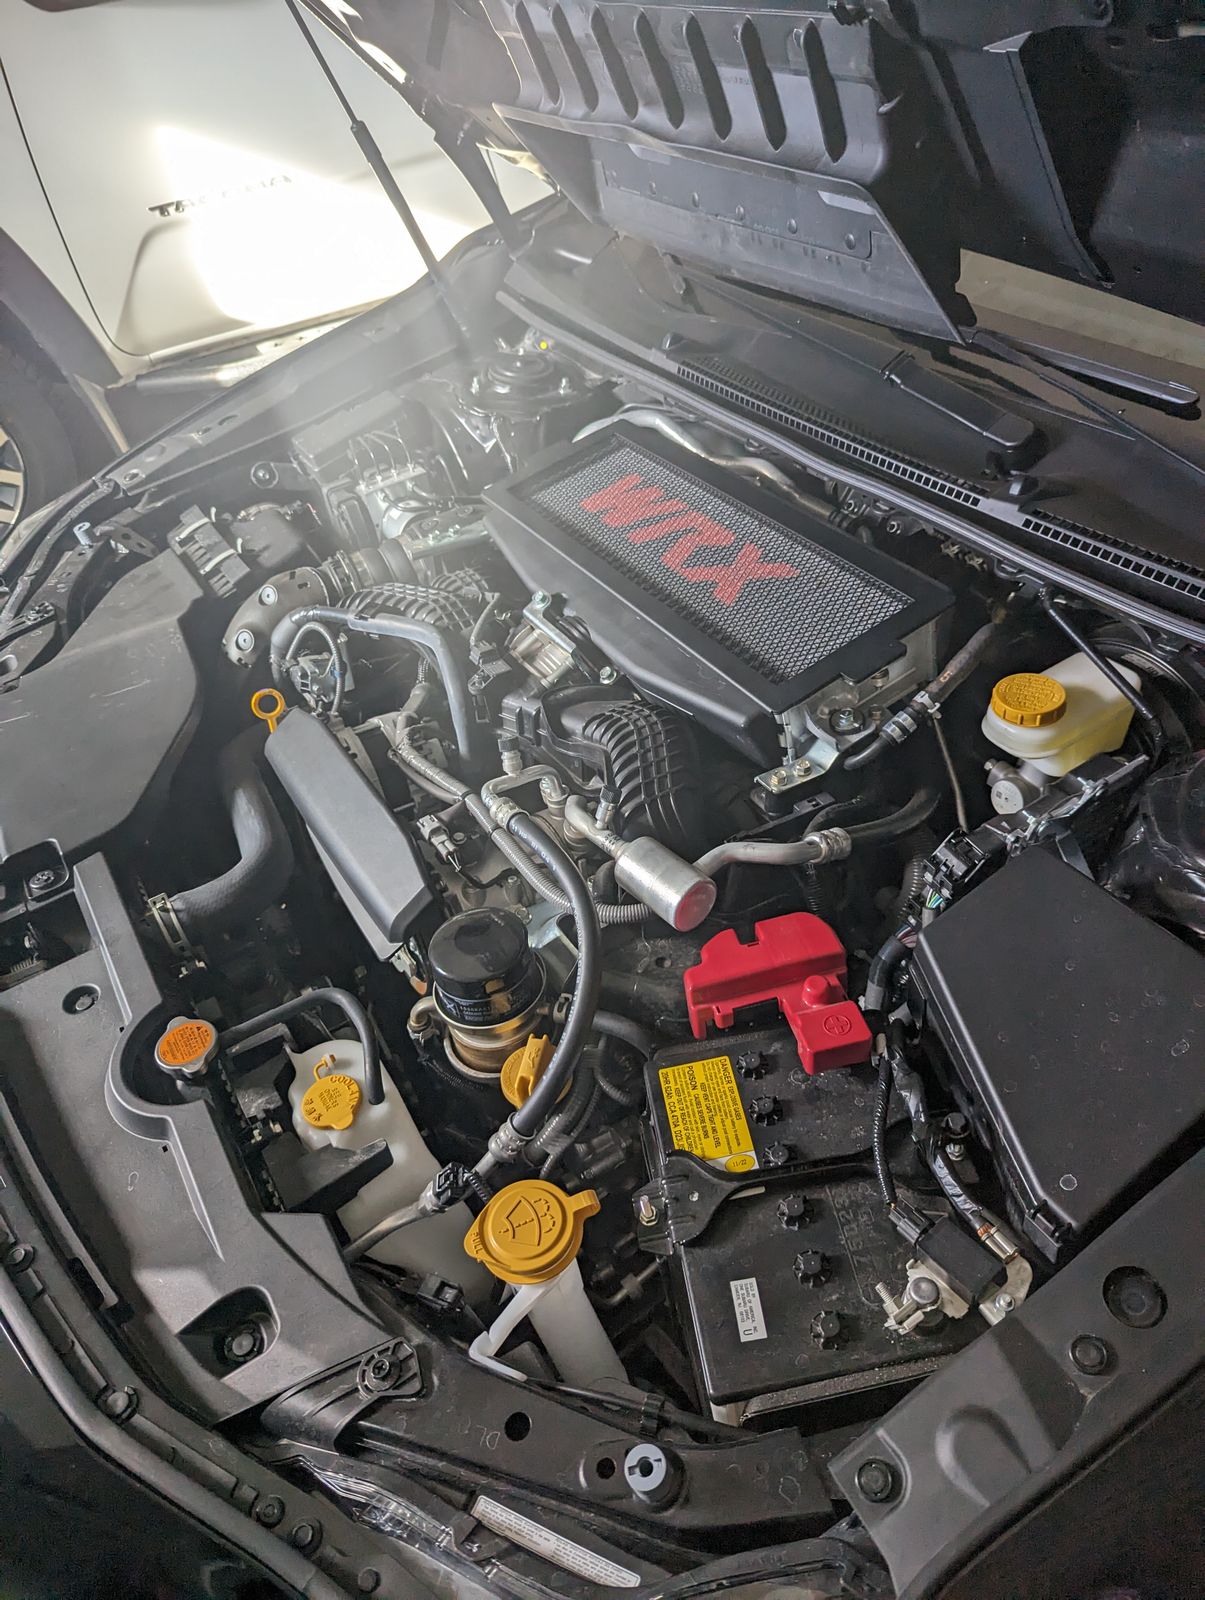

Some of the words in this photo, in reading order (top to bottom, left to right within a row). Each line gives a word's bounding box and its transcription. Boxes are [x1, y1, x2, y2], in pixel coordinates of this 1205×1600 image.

[581, 473, 800, 606] WRX
[686, 1066, 699, 1091] POISON
[720, 1058, 733, 1085] DANGER
[699, 1082, 708, 1093] KEEP
[693, 1094, 703, 1109] CAUSES
[702, 1093, 710, 1103] VENT
[728, 1086, 739, 1107] EXPLOSIVE
[668, 1101, 677, 1114] CCA
[674, 1087, 682, 1097] KEEP
[680, 1112, 688, 1126] REACH
[705, 1103, 713, 1114] CAPS
[697, 1109, 707, 1125] SEVERE
[707, 1114, 716, 1125] TIGHT
[733, 1107, 742, 1121] GASES
[710, 1125, 718, 1135] AND
[713, 1135, 722, 1148] LEVEL
[470, 1231, 483, 1254] PULL
